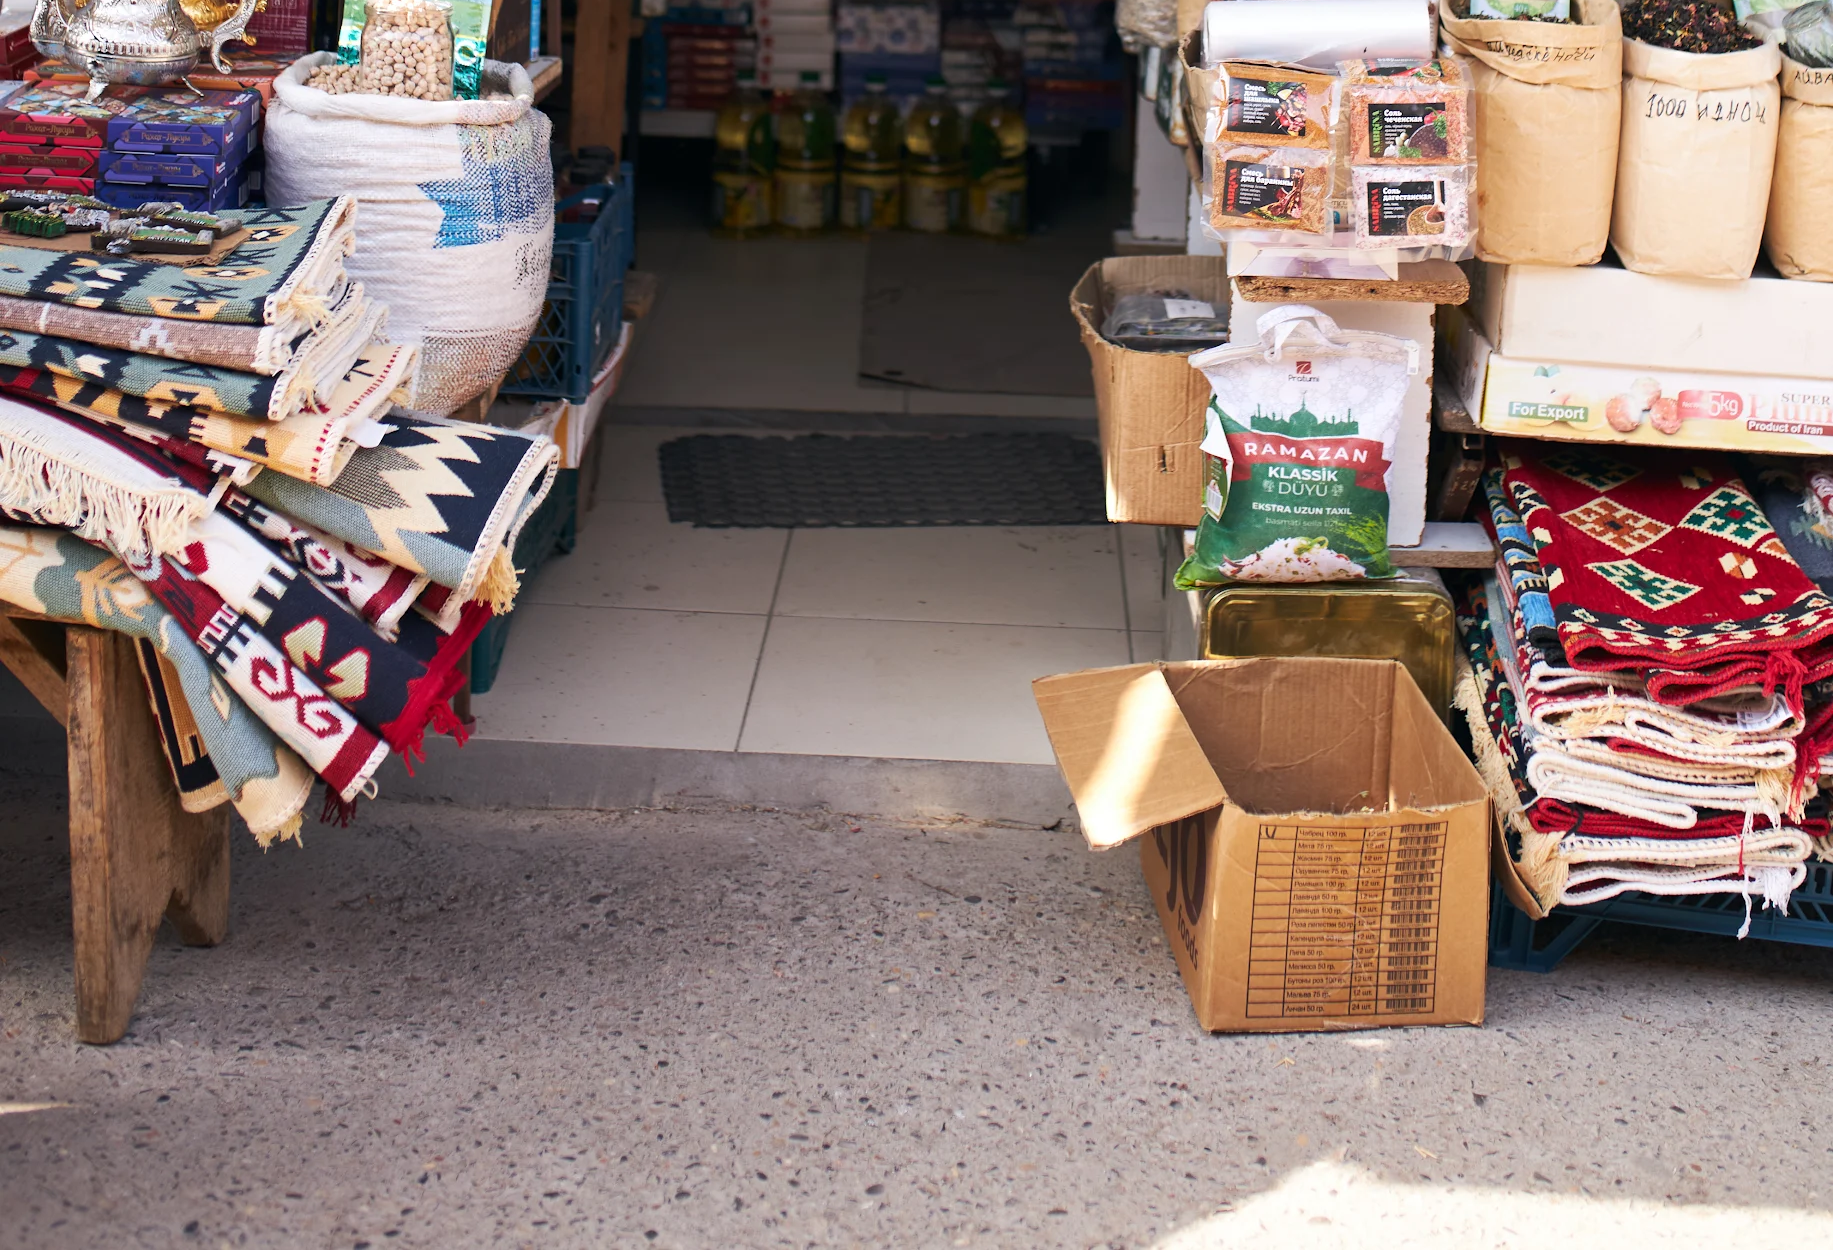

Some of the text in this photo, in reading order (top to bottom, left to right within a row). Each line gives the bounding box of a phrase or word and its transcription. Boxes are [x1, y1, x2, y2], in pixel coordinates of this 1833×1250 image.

[1244, 83, 1266, 92] Смесь
[1244, 96, 1280, 104] шашлыка
[1646, 94, 1686, 119] 1000
[25, 123, 75, 136] Рахат-Лукум
[141, 132, 191, 143] Рахат-Лукум
[1241, 168, 1263, 177] Смесь
[1256, 178, 1294, 187] баранины
[1382, 187, 1401, 195] Соль
[1383, 194, 1432, 202] дагестанская
[1707, 392, 1738, 417] 5kg
[1781, 392, 1830, 405] SUPER
[1511, 403, 1585, 421] For Export
[1748, 420, 1823, 435] Product of Iran
[1244, 442, 1368, 463] RAMAZAN
[1278, 480, 1328, 497] DÜYÜ
[1252, 502, 1352, 516] EKSTRA UZUN TAXIL
[1265, 517, 1299, 526] basmati
[1302, 518, 1322, 527] sella
[1292, 907, 1320, 915] Лаванда
[1178, 904, 1198, 970] foods
[1290, 935, 1324, 943] Календула
